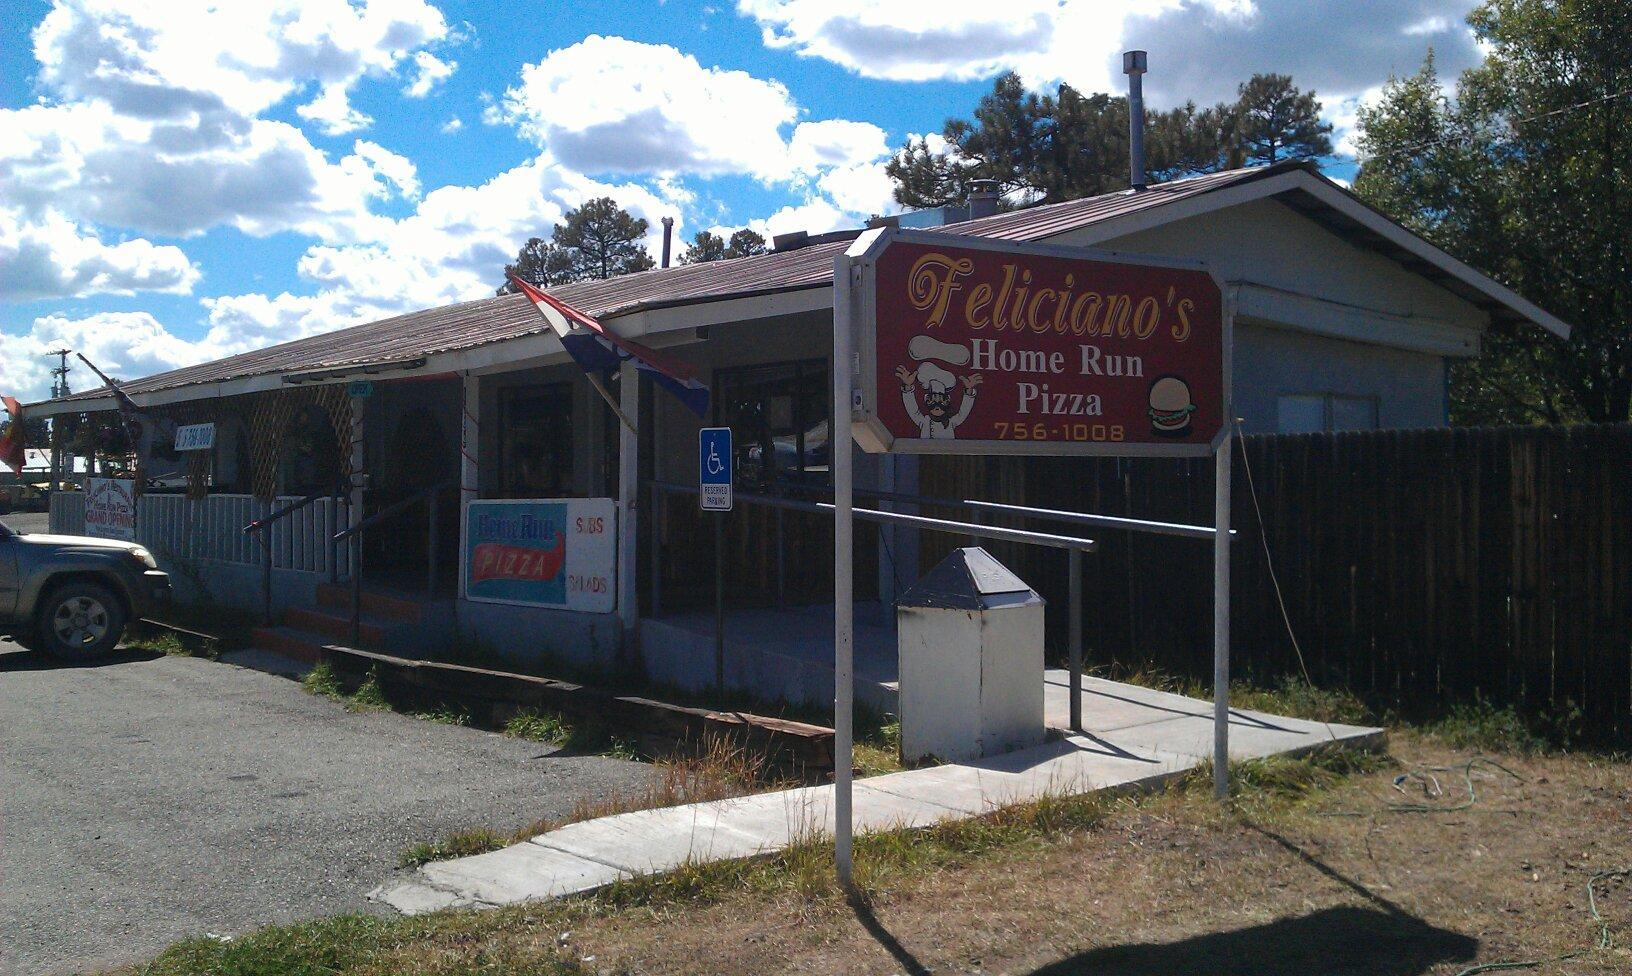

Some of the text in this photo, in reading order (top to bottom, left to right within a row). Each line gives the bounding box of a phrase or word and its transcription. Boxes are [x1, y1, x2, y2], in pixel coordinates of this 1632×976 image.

[907, 252, 1195, 343] Feliciano's
[970, 338, 1143, 377] Home Run
[1016, 382, 1103, 416] Pizza
[993, 422, 1125, 442] 756-1008
[704, 486, 728, 495] RESERVED
[481, 551, 546, 577] PIZZA
